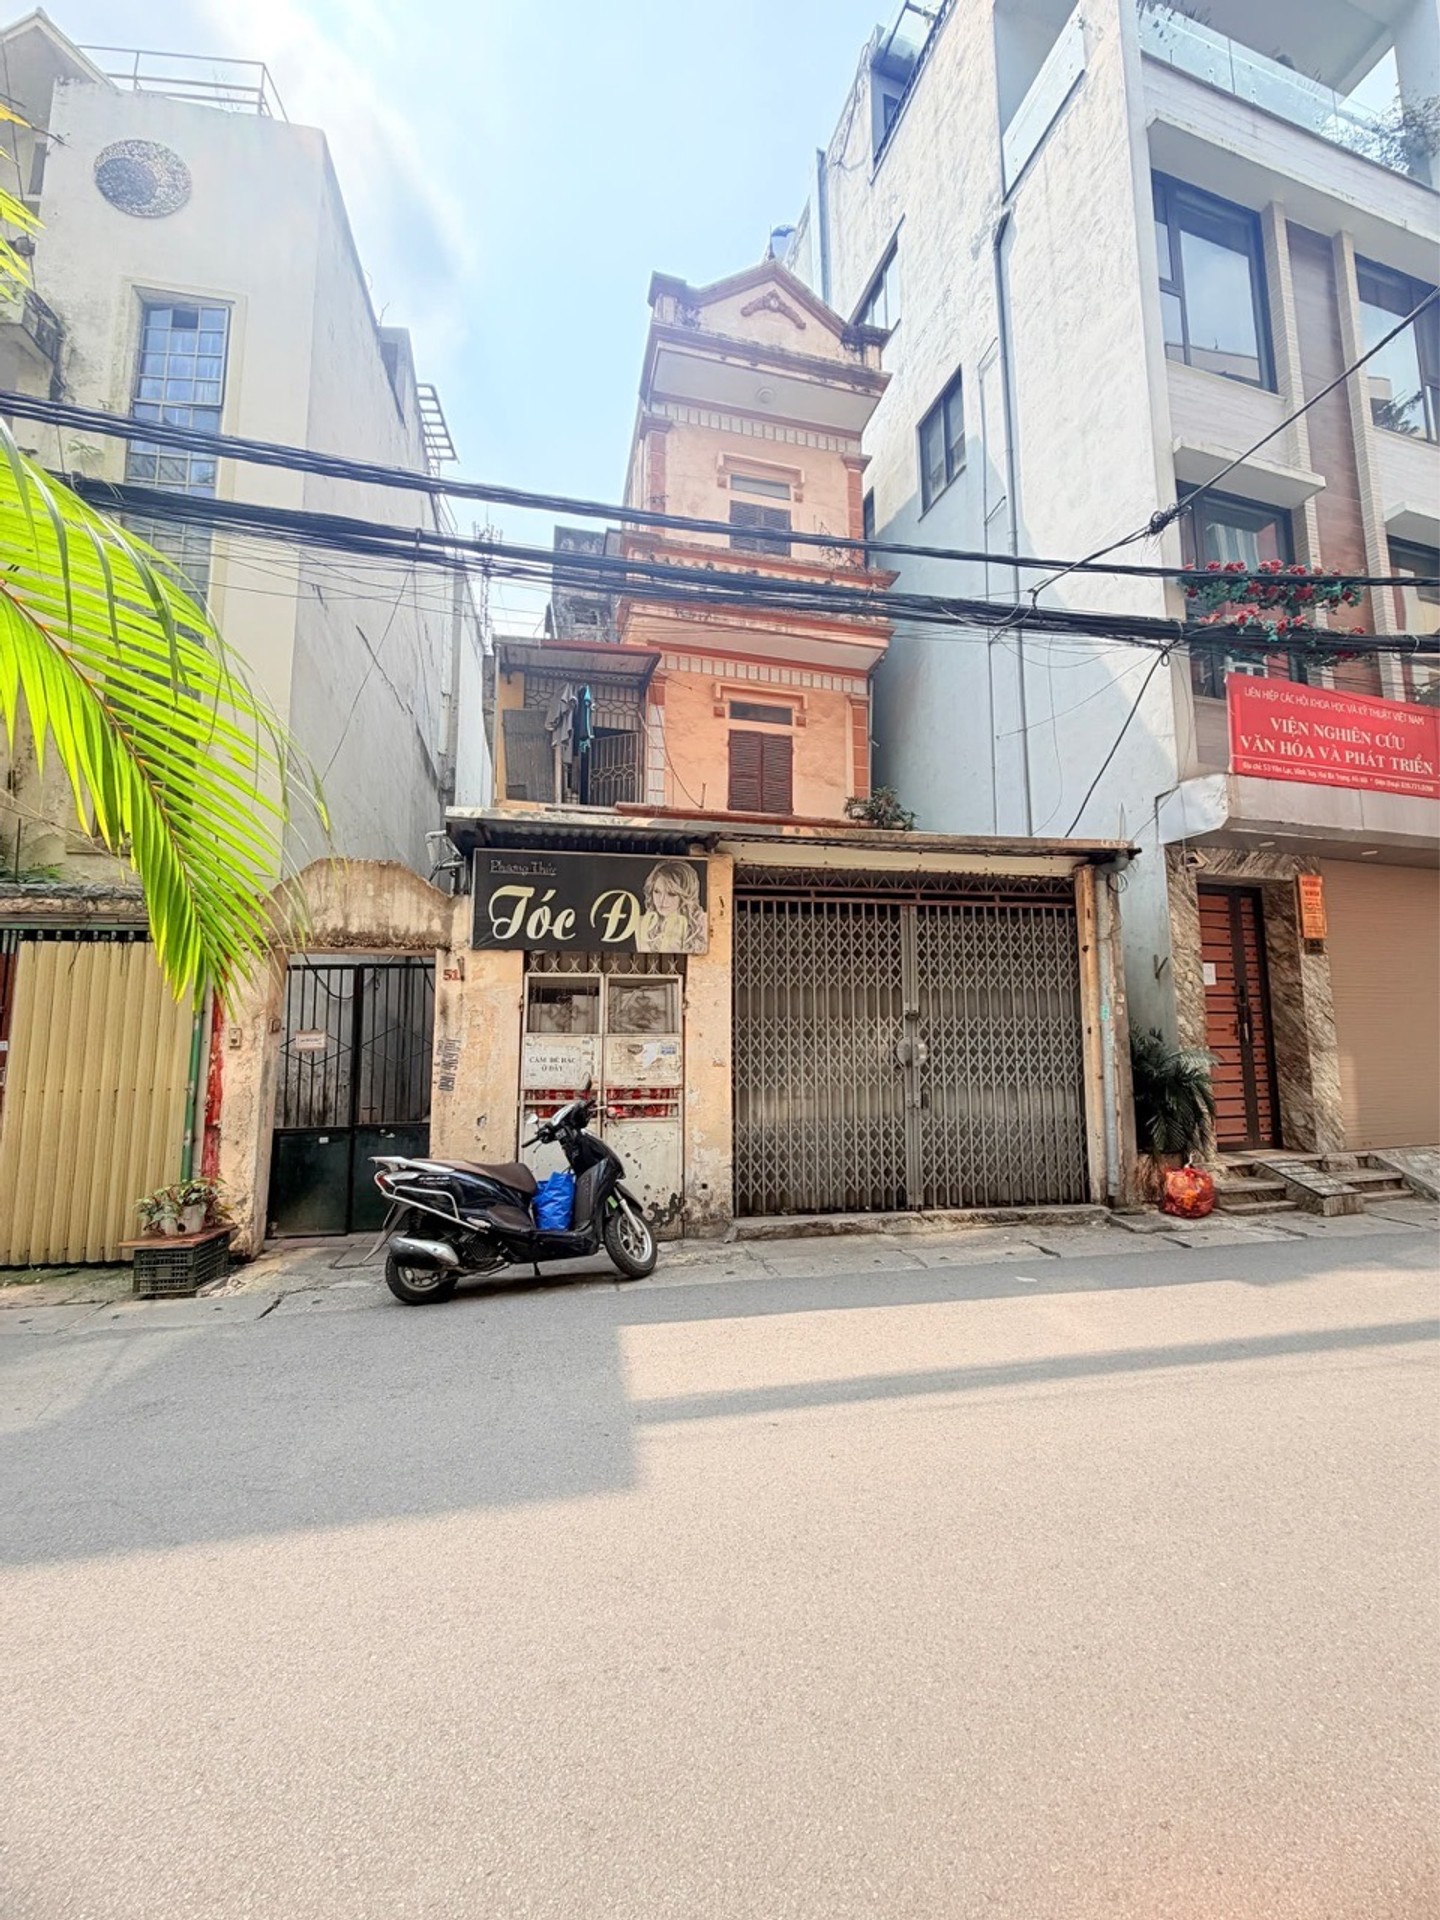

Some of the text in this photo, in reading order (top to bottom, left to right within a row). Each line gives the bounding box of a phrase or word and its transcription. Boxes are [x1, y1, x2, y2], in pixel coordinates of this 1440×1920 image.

[1280, 692, 1295, 704] CÁC
[1270, 716, 1405, 751] VIỆN NGHIÊN CỨU
[1240, 734, 1433, 775] VĂN HÓA VÀ PHÁT TRIỂN
[489, 885, 577, 941] Tóc
[442, 969, 460, 981] 51
